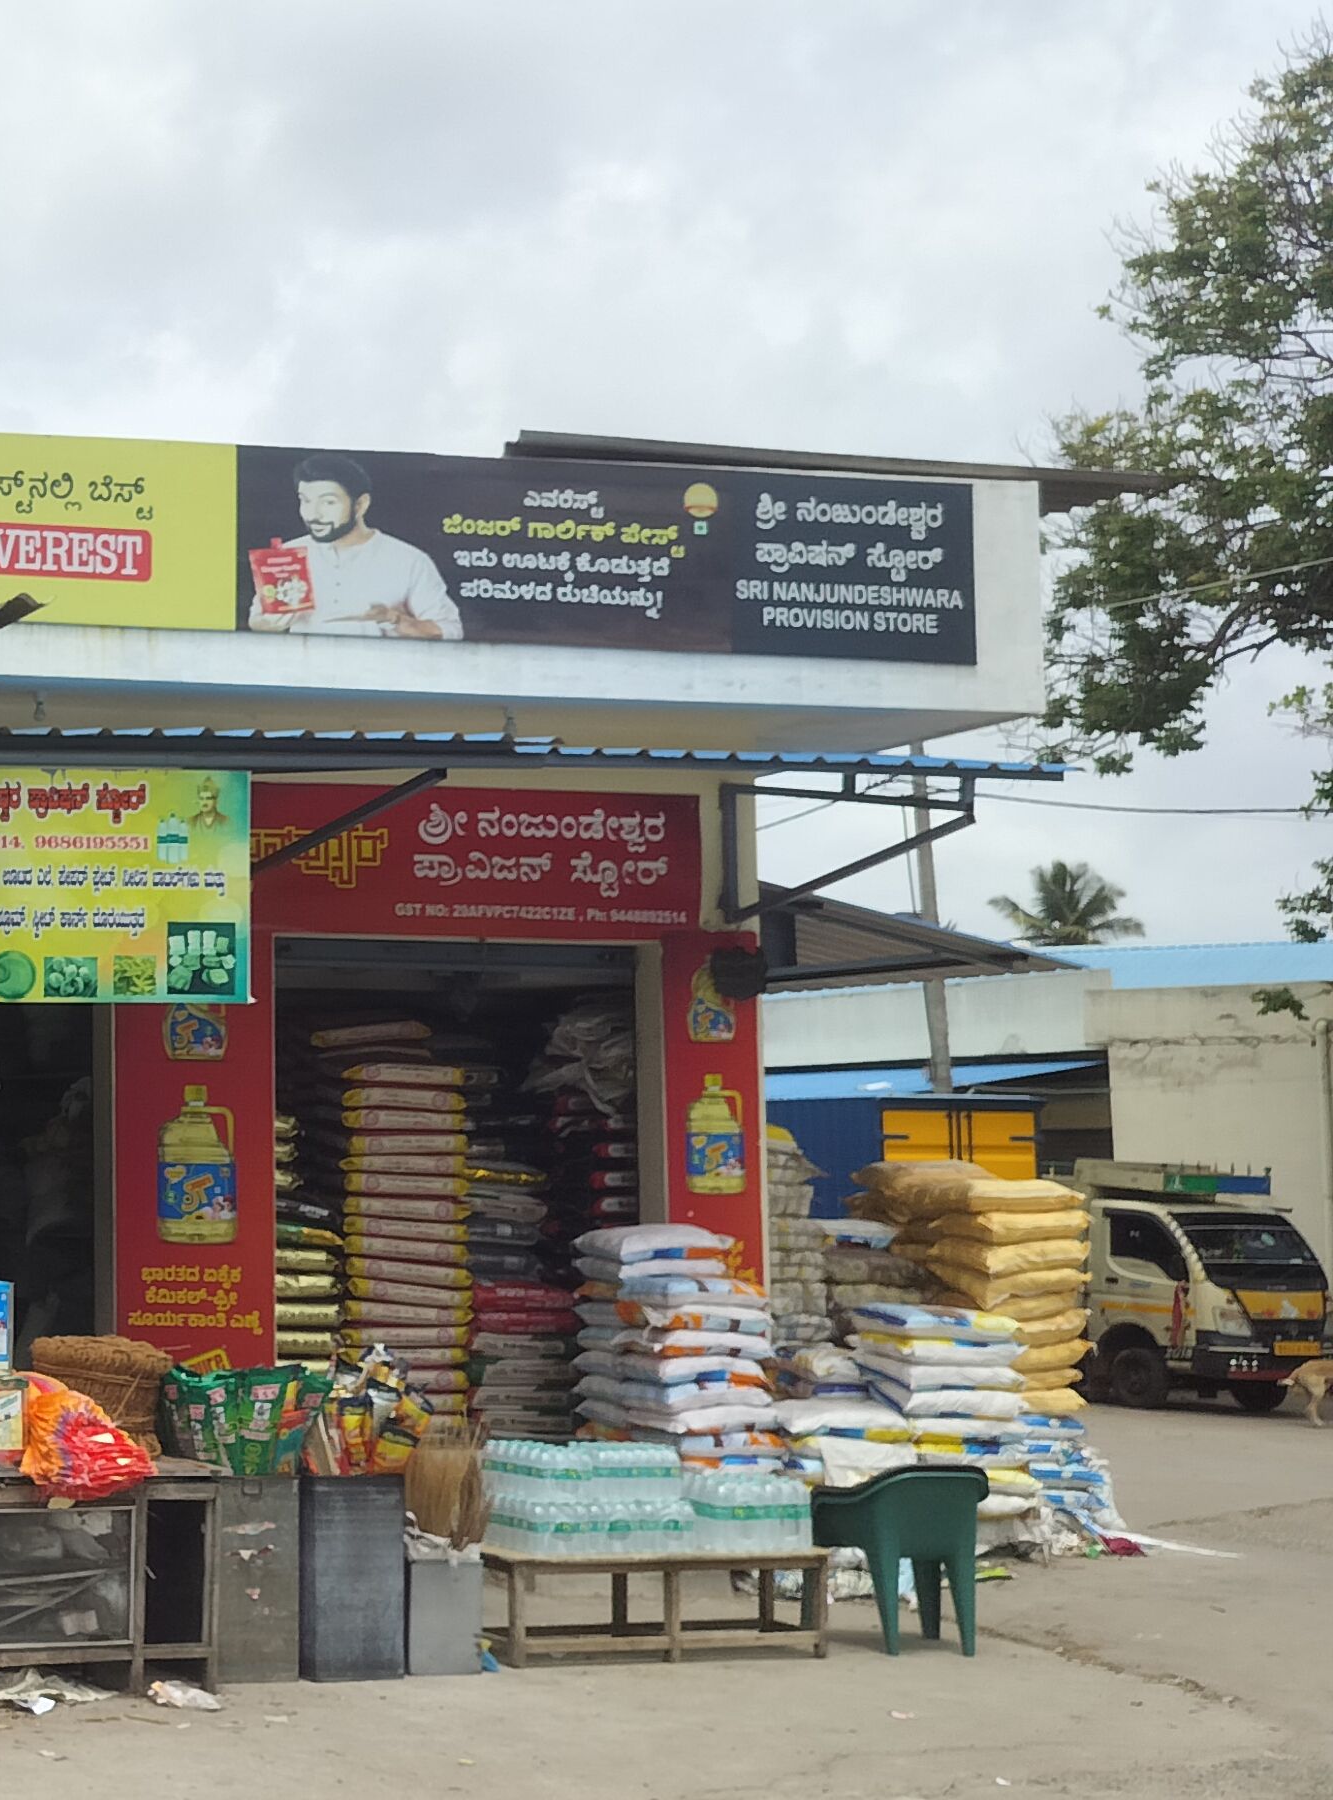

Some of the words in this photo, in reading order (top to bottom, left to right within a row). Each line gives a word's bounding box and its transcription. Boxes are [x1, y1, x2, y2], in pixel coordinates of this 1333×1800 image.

[88, 476, 153, 521] ಬೆಸ್ಟ್
[523, 489, 604, 518] ಎವರೆಸ್ಟ್
[755, 492, 788, 530] ಶ್ರೀ
[796, 495, 944, 541] ನಂಜುಂಡೇಶ್ವರ
[620, 523, 686, 558] ಪೇಸ್ಟ್
[453, 547, 497, 568] ಇದು
[502, 550, 574, 583] ಊಟಕ್ಕೆ
[575, 552, 671, 583] ಕೊಡುತ್ತದೆ
[755, 539, 856, 574] ಪ್ರಾವಿಷನ್
[866, 543, 944, 582] ಸ್ಟೋರ್
[460, 578, 553, 603] ಪರಿಮಳದ
[736, 579, 768, 601] SRI
[771, 582, 963, 610] NANJUNDESHWARA
[762, 607, 870, 631] PROVISION
[873, 611, 939, 634] STORE
[418, 801, 466, 846] ಶ್ರೀ
[477, 805, 666, 854] ನಂಜುಂಡೇಶ್ವರ
[413, 851, 552, 887] ಪ್ರಾವಿಜನ್
[570, 852, 669, 899] ಸ್ಟೋರ್
[394, 903, 423, 917] GST
